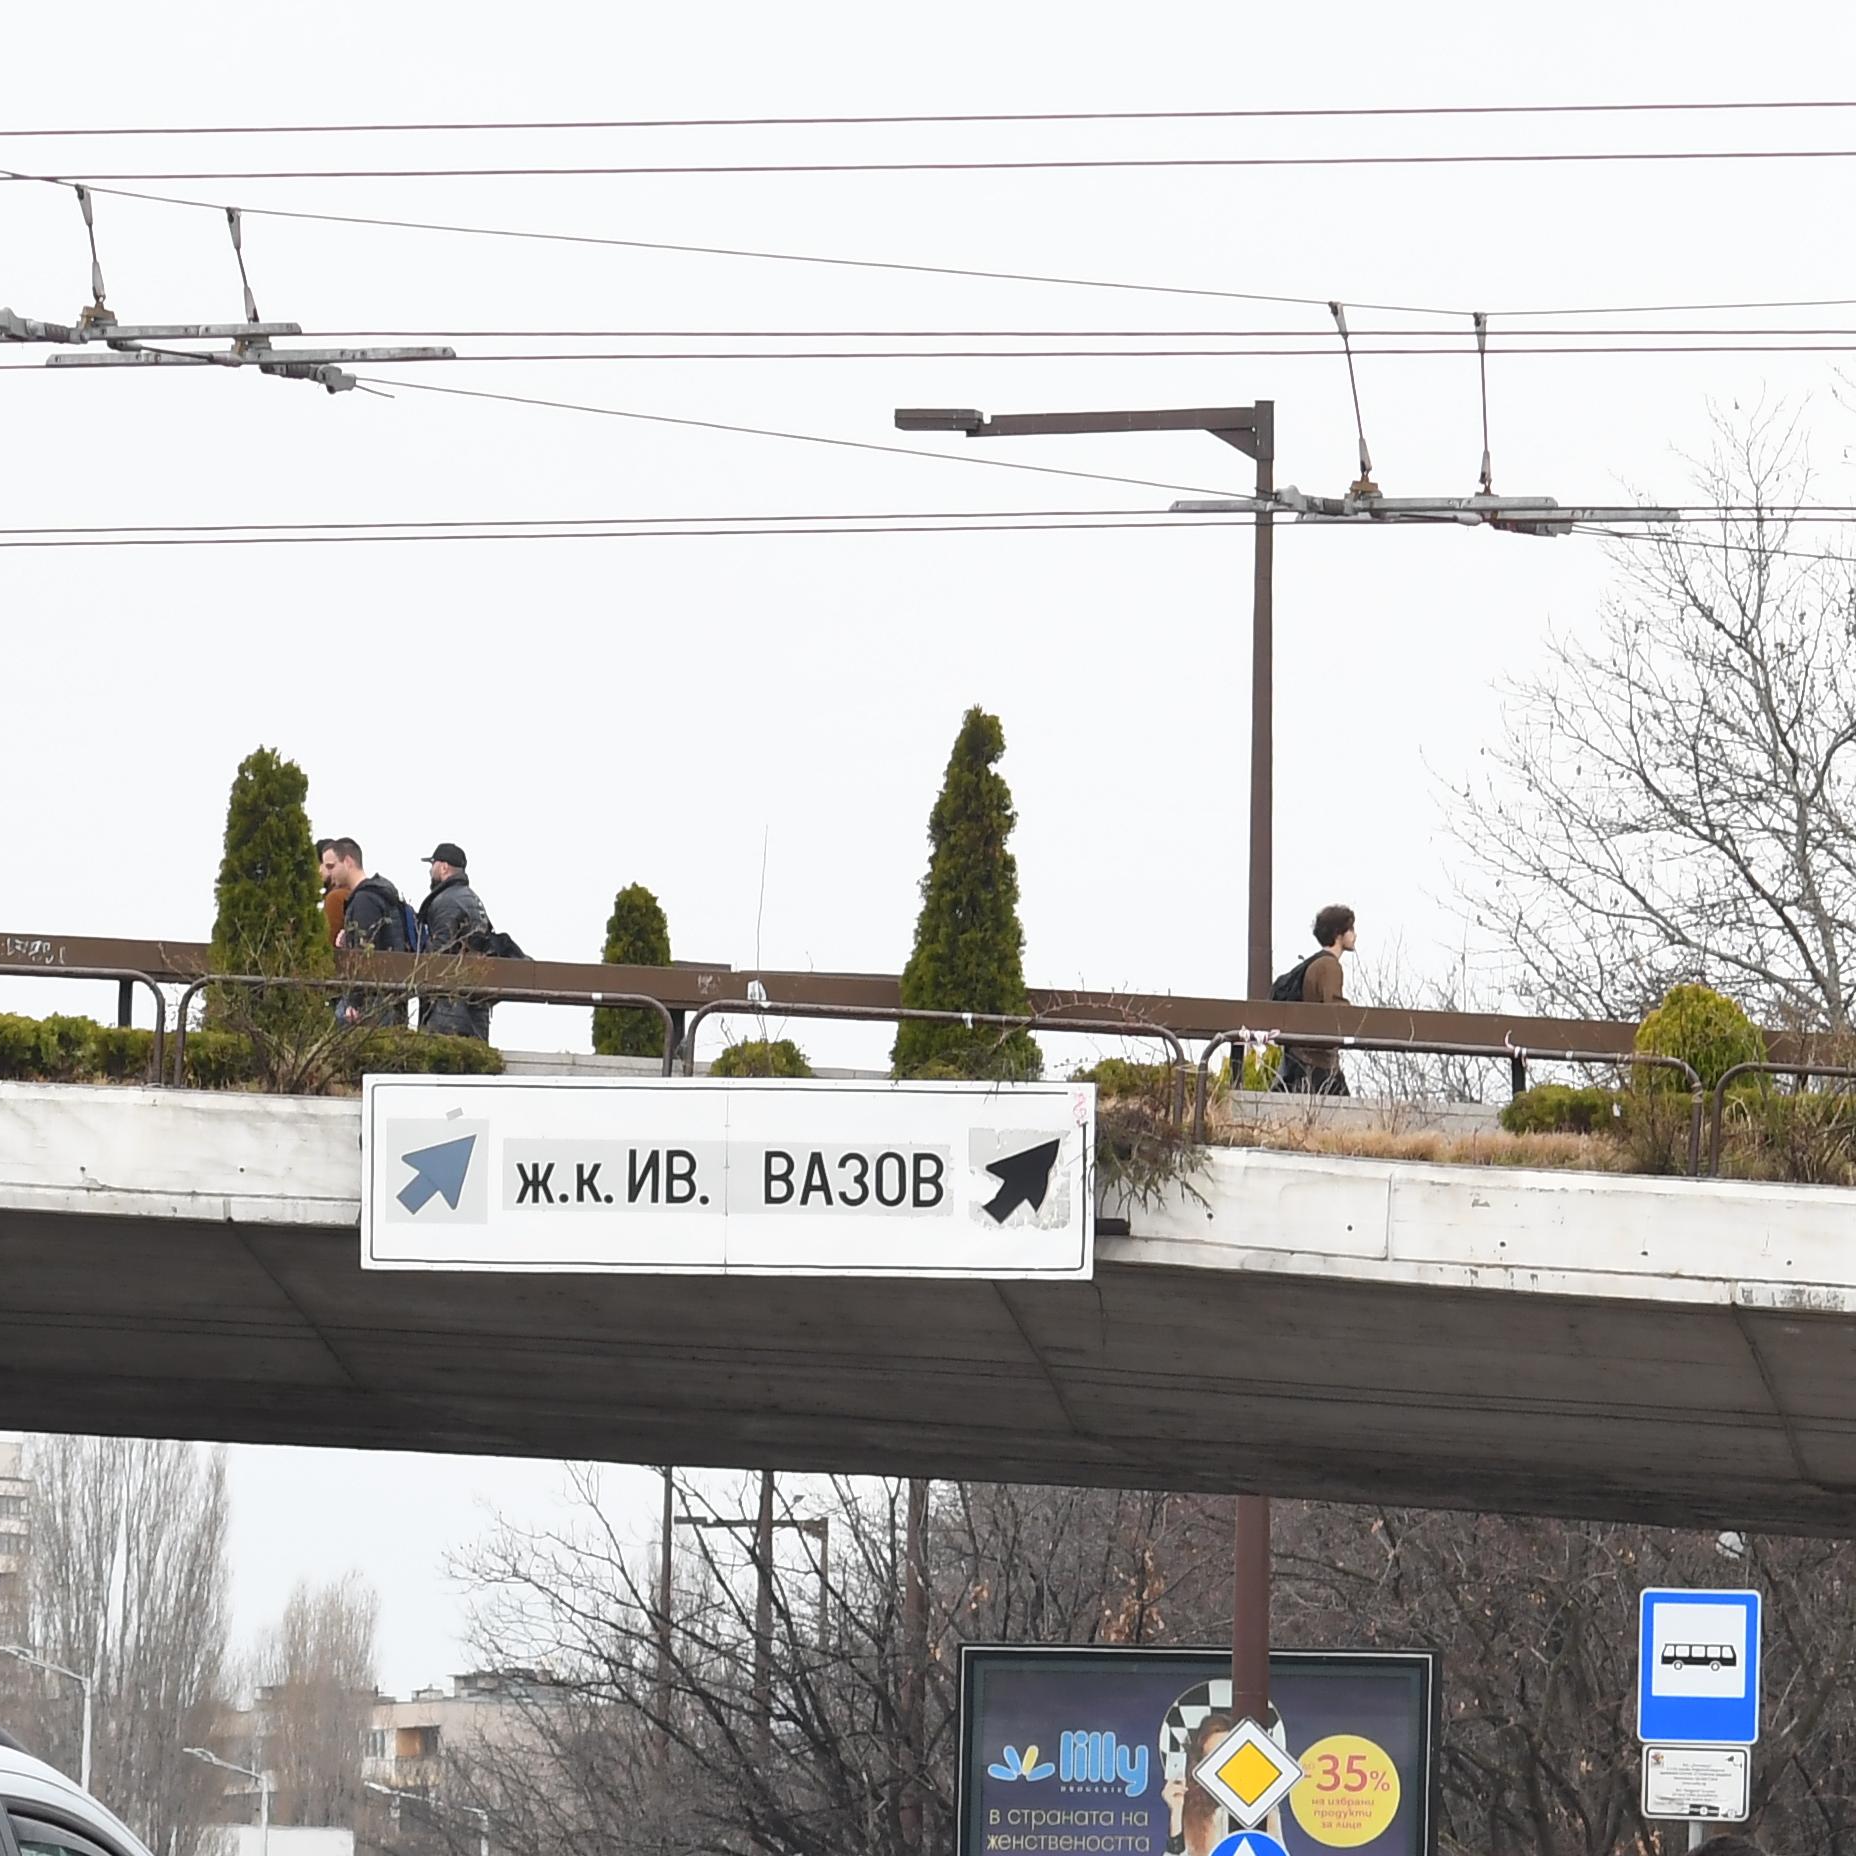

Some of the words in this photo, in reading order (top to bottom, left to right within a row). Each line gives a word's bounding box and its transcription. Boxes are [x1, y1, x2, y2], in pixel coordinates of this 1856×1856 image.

[628, 1149, 710, 1206] ИВ.
[763, 1151, 945, 1208] ВАЗОВ
[1059, 1731, 1148, 1797] lilly
[1008, 1809, 1113, 1830] страната
[1121, 1811, 1148, 1827] на
[987, 1834, 1150, 1852] женствеността
